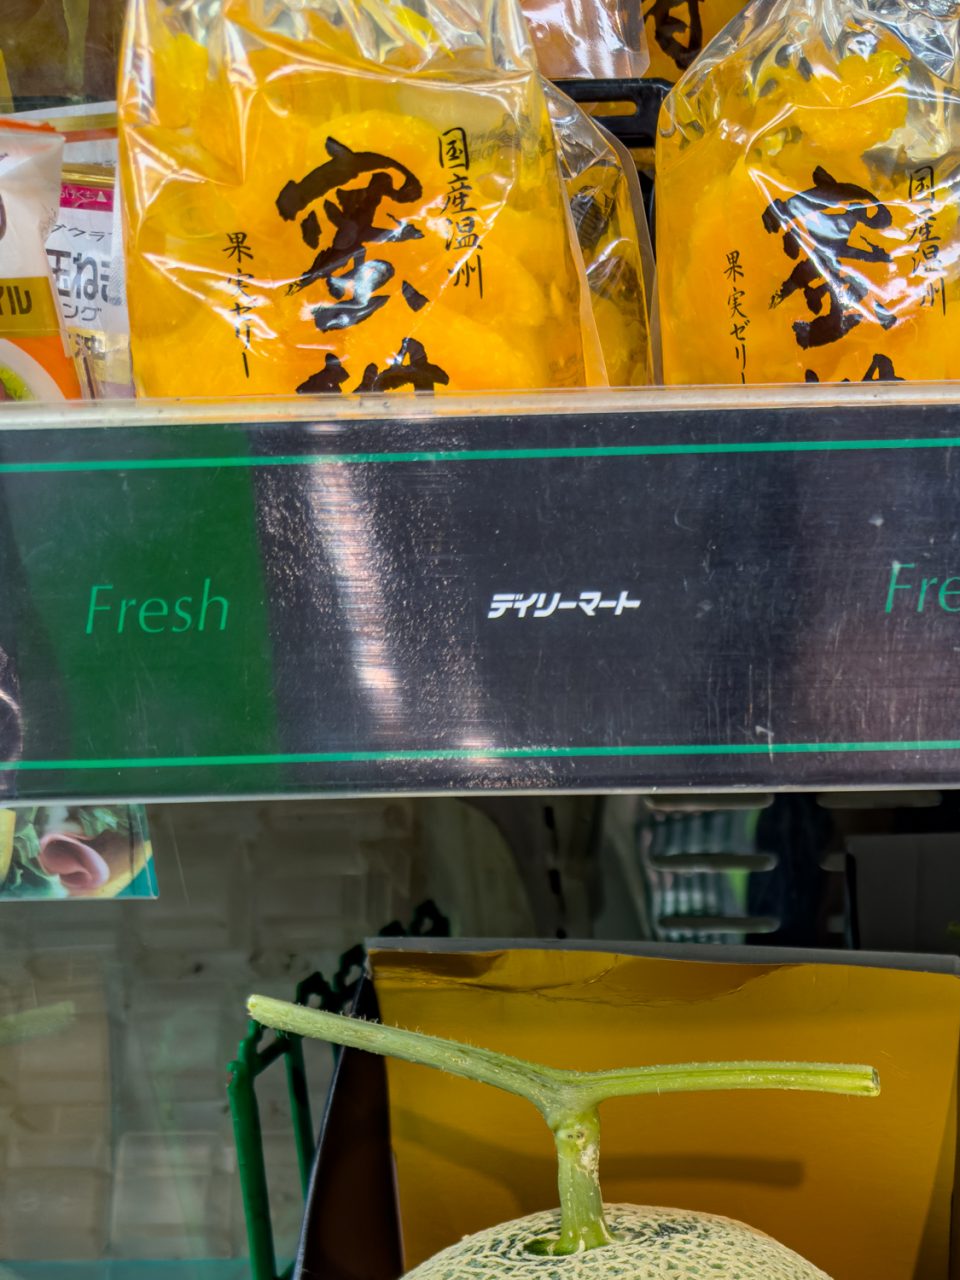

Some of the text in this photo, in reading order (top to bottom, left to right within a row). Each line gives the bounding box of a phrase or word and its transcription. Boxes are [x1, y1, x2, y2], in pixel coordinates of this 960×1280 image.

[438, 127, 484, 299] 国産温州
[85, 578, 229, 634] Fresh
